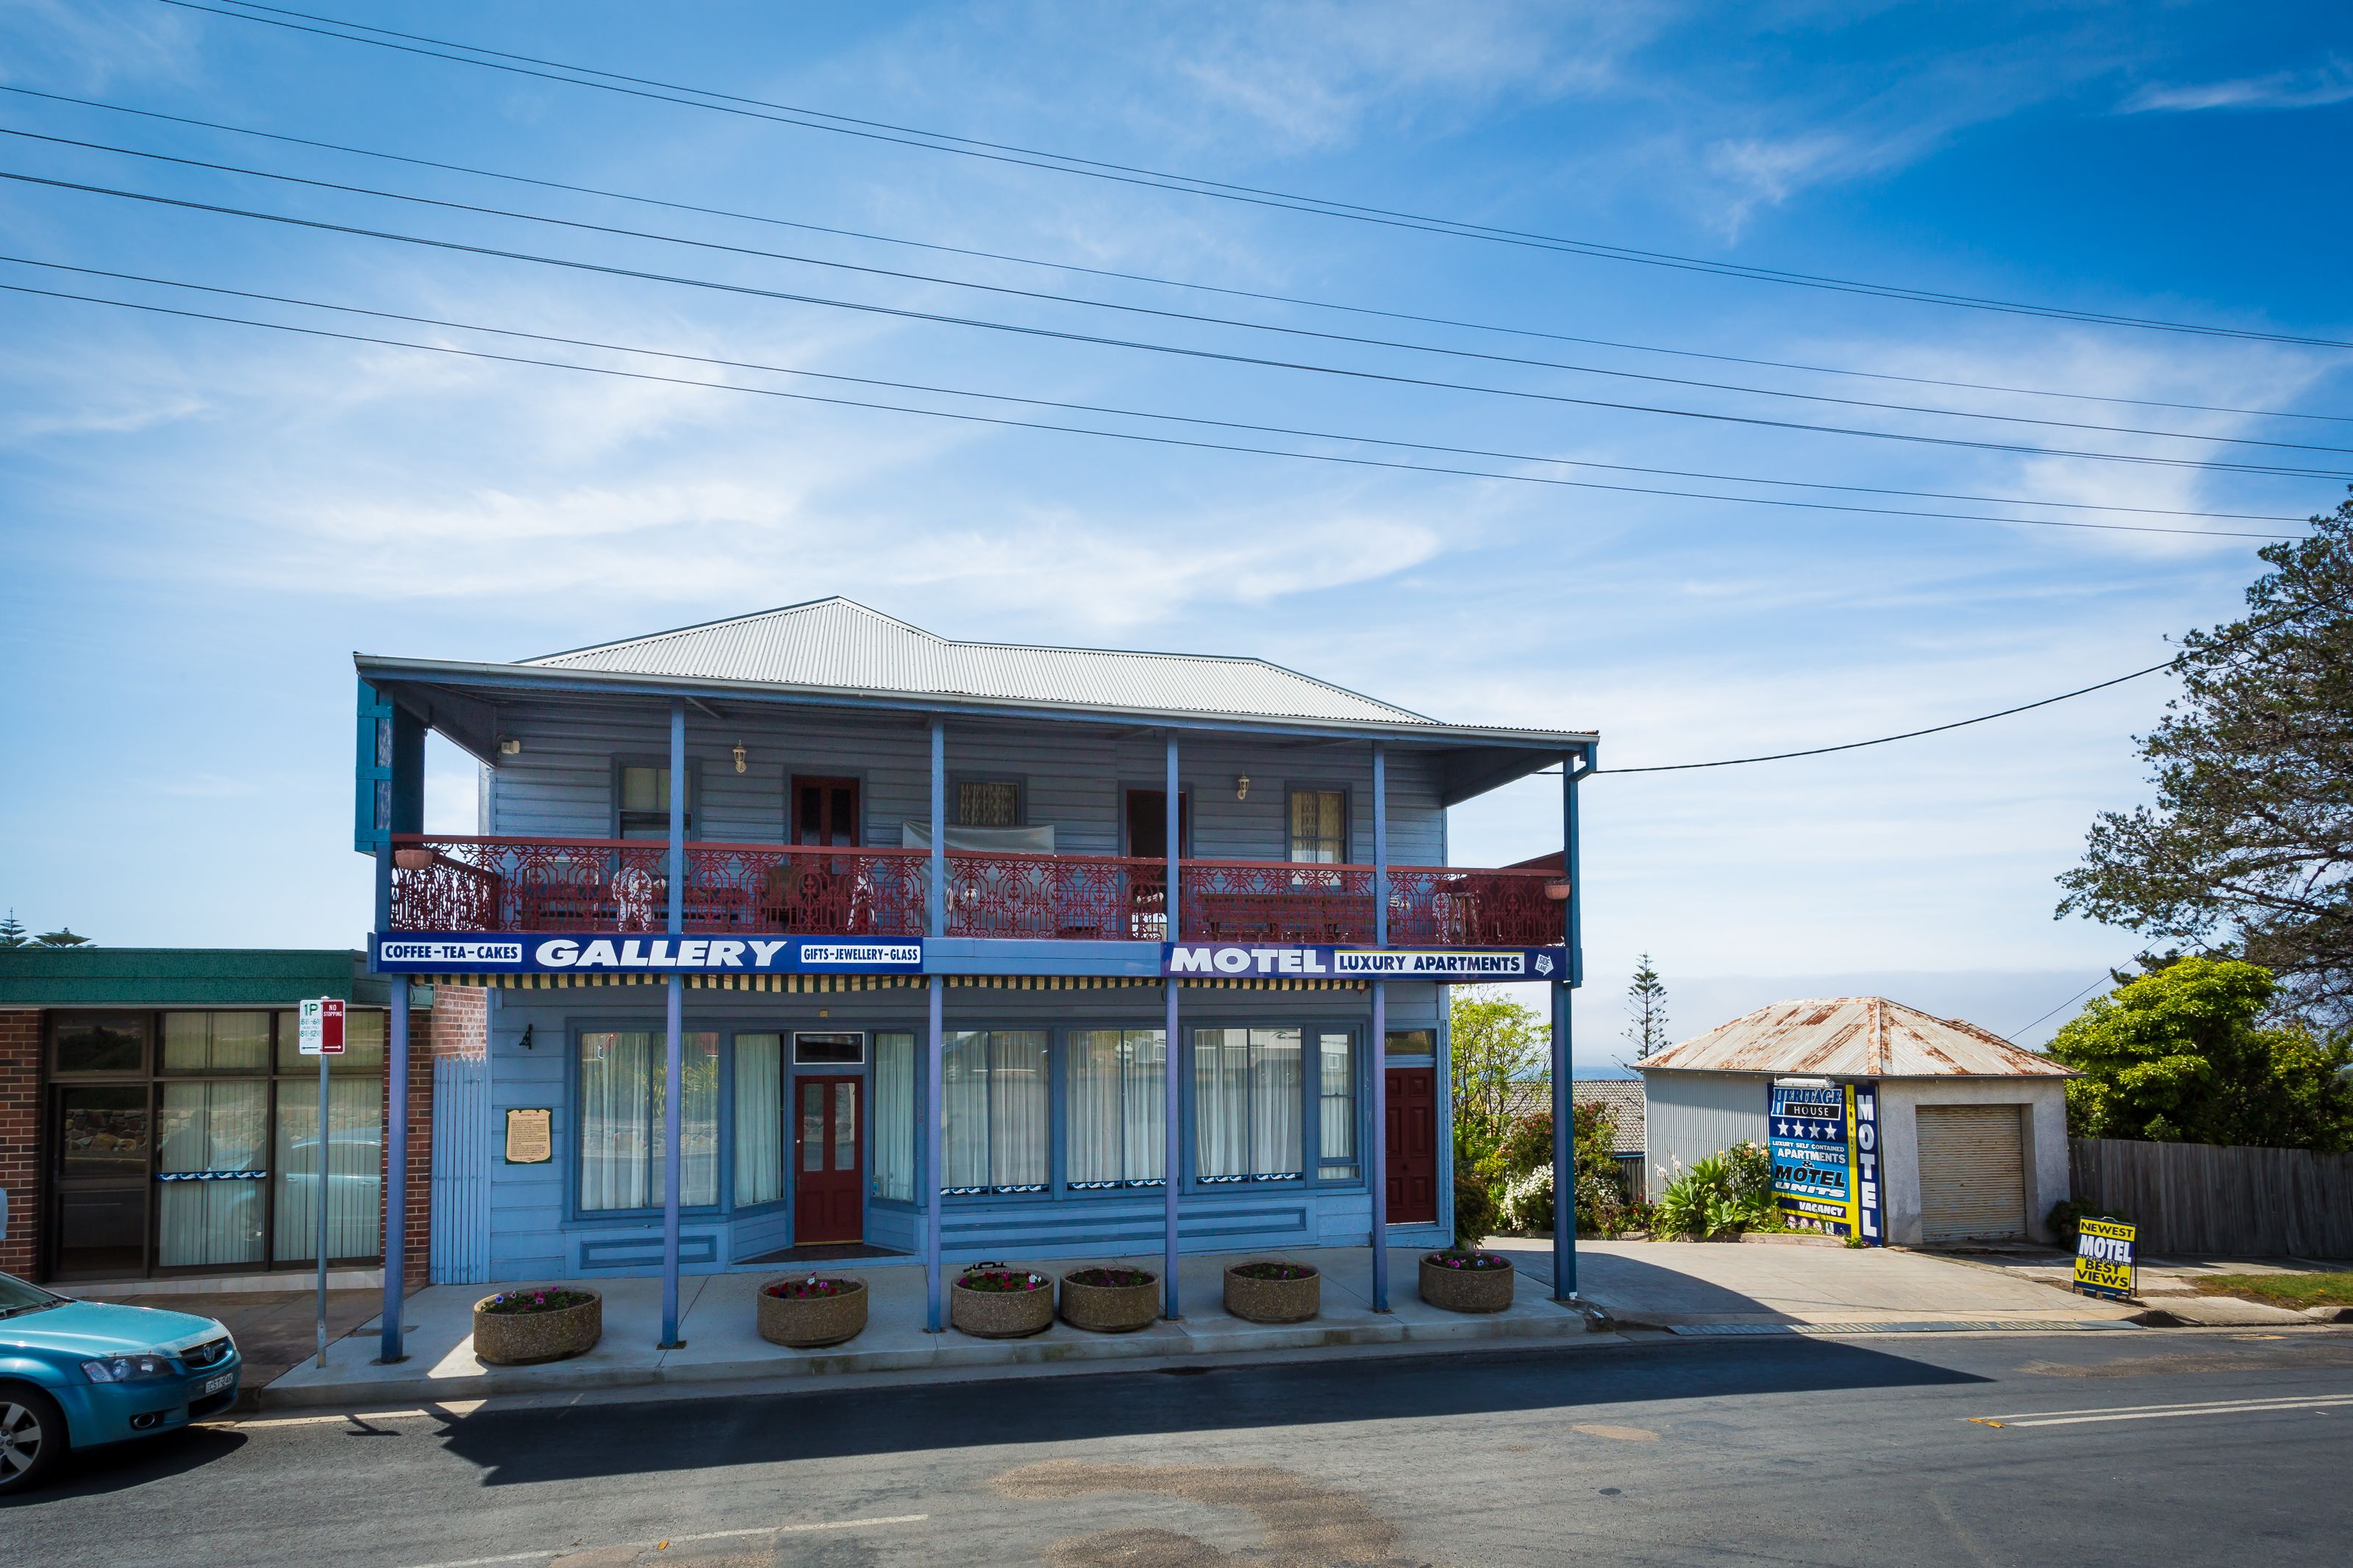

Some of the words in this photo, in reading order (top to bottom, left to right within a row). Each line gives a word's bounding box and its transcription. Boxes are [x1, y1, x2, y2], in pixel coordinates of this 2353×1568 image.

[535, 939, 788, 967] GALLERY
[1170, 947, 1326, 973] MOTEL
[1539, 956, 1550, 967] SIDE
[1339, 955, 1405, 970] LUXURY
[1413, 956, 1521, 972] APARTMENTS
[304, 1003, 318, 1016] 1P
[1771, 1087, 1842, 1115] HERITAGE
[1793, 1106, 1829, 1117] HOUSE
[1777, 1148, 1846, 1164] APARTMENTS
[1811, 1144, 1845, 1153] CONTAINED
[1802, 1159, 1814, 1168] &
[1857, 1095, 1877, 1238] MOTEL
[1774, 1164, 1846, 1188] MOTEL
[1774, 1181, 1846, 1198] UNITS
[1799, 1201, 1844, 1217] VACANCY
[2080, 1221, 2134, 1238] NEWEST
[2078, 1234, 2132, 1264] MOTEL
[2085, 1259, 2121, 1275] BEST
[2076, 1268, 2129, 1288] VIEWS
